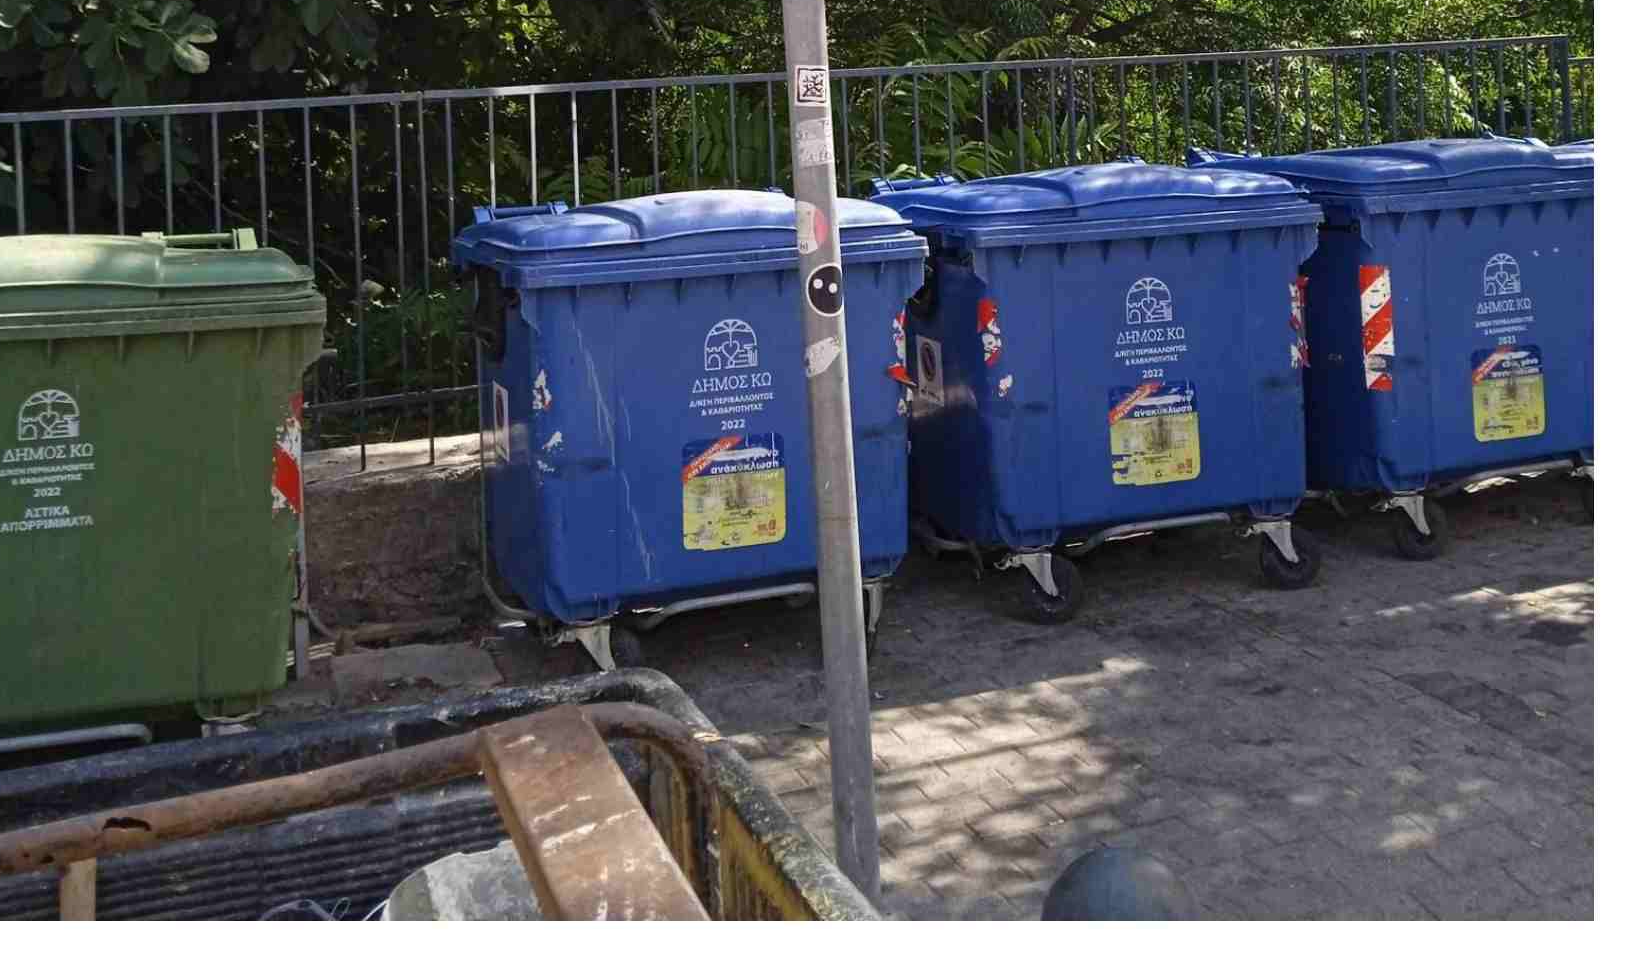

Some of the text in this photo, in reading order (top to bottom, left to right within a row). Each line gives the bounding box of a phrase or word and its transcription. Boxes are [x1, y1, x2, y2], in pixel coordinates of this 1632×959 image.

[1476, 297, 1532, 314] ΔΗΜΟΣ ΚΩ
[1117, 327, 1185, 345] ΔΗΜΟΣ ΚΩ
[692, 372, 772, 393] ΔΗΜΟΣ ΚΩ
[1142, 369, 1164, 379] 2022
[721, 419, 745, 430] 2022
[2, 443, 94, 463] ΔΗΜΟΣ ΚΩ
[33, 487, 61, 498] 2022
[24, 506, 70, 519] ΑΣΤΙΚΑ
[0, 515, 95, 532] ΑΠΟΡΡΙΜΜΑΤΑ
